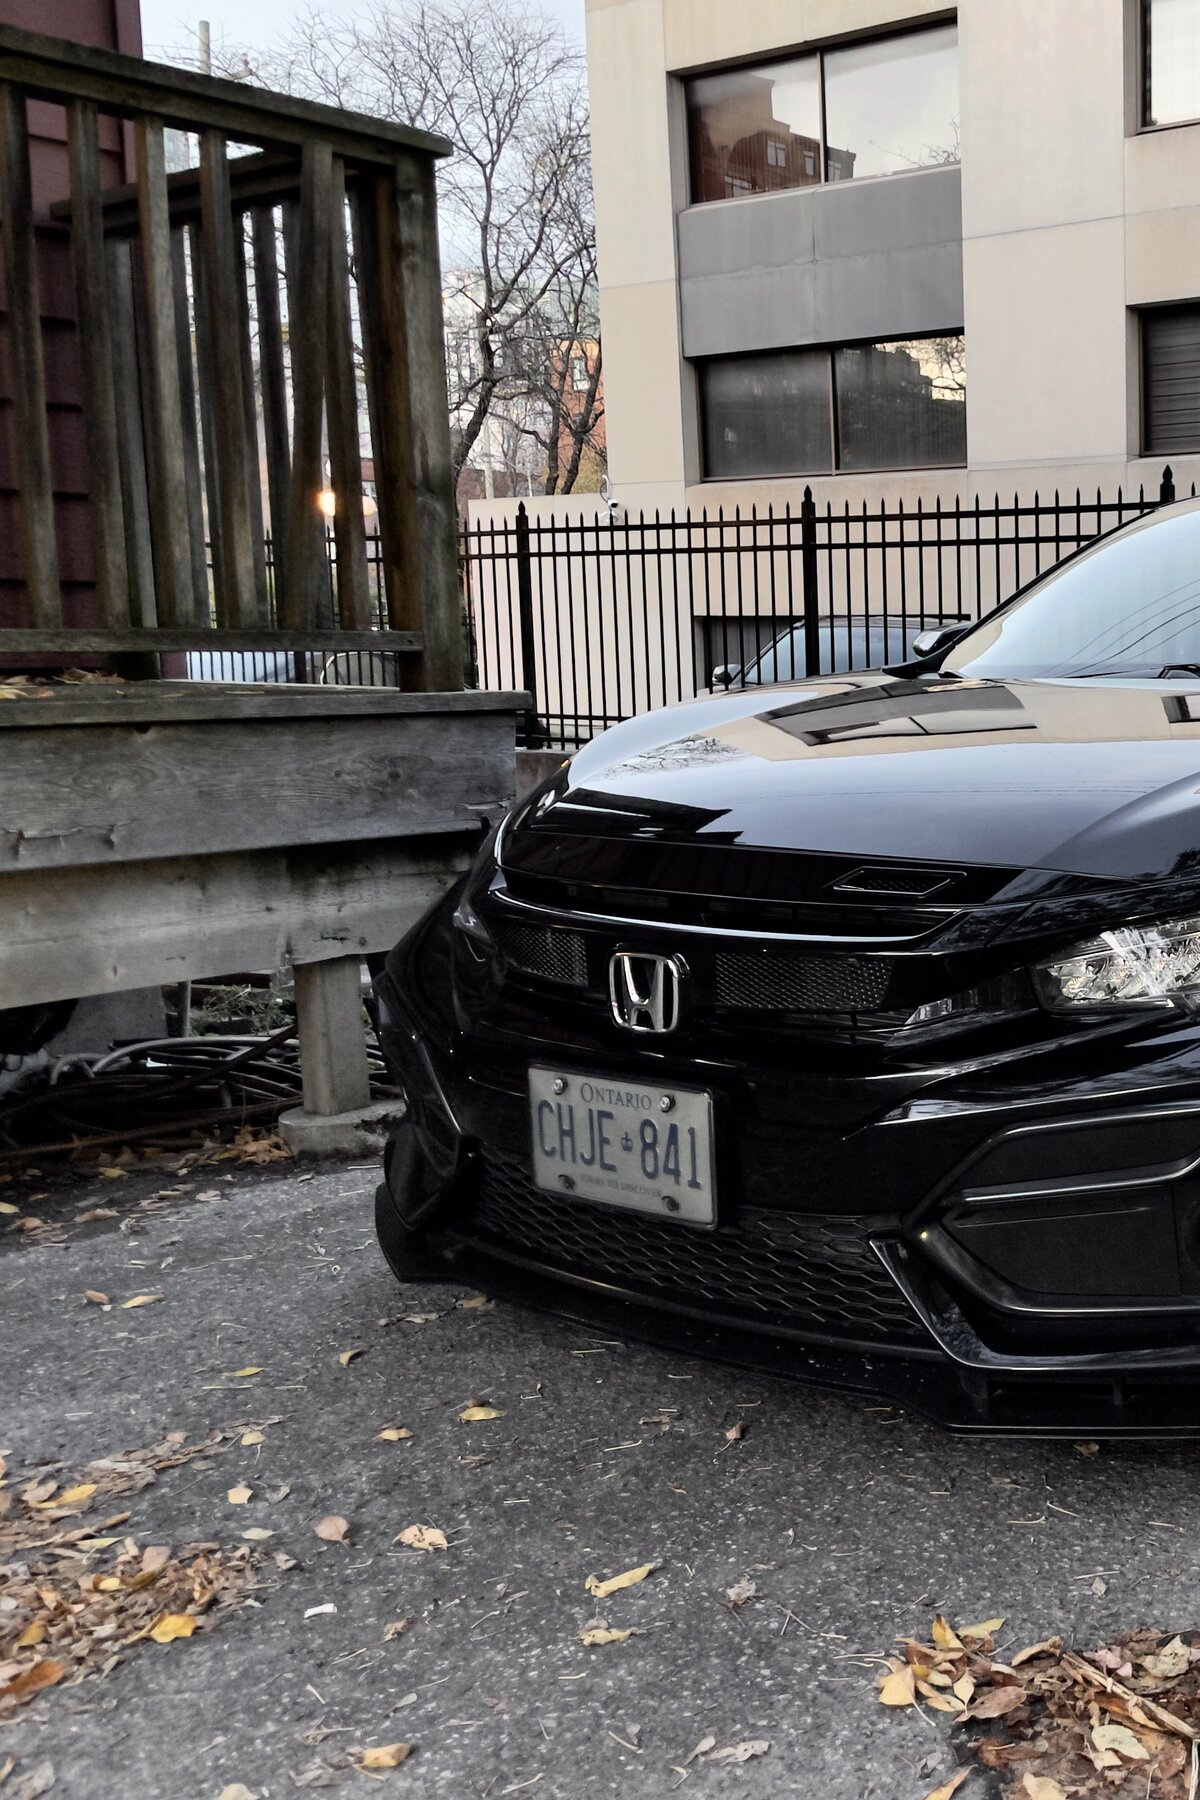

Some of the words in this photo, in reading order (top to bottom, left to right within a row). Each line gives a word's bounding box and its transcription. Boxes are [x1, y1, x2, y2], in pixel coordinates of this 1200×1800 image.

[580, 1082, 651, 1111] ONTARIO
[537, 1099, 617, 1172] CHJE
[639, 1118, 702, 1190] 841
